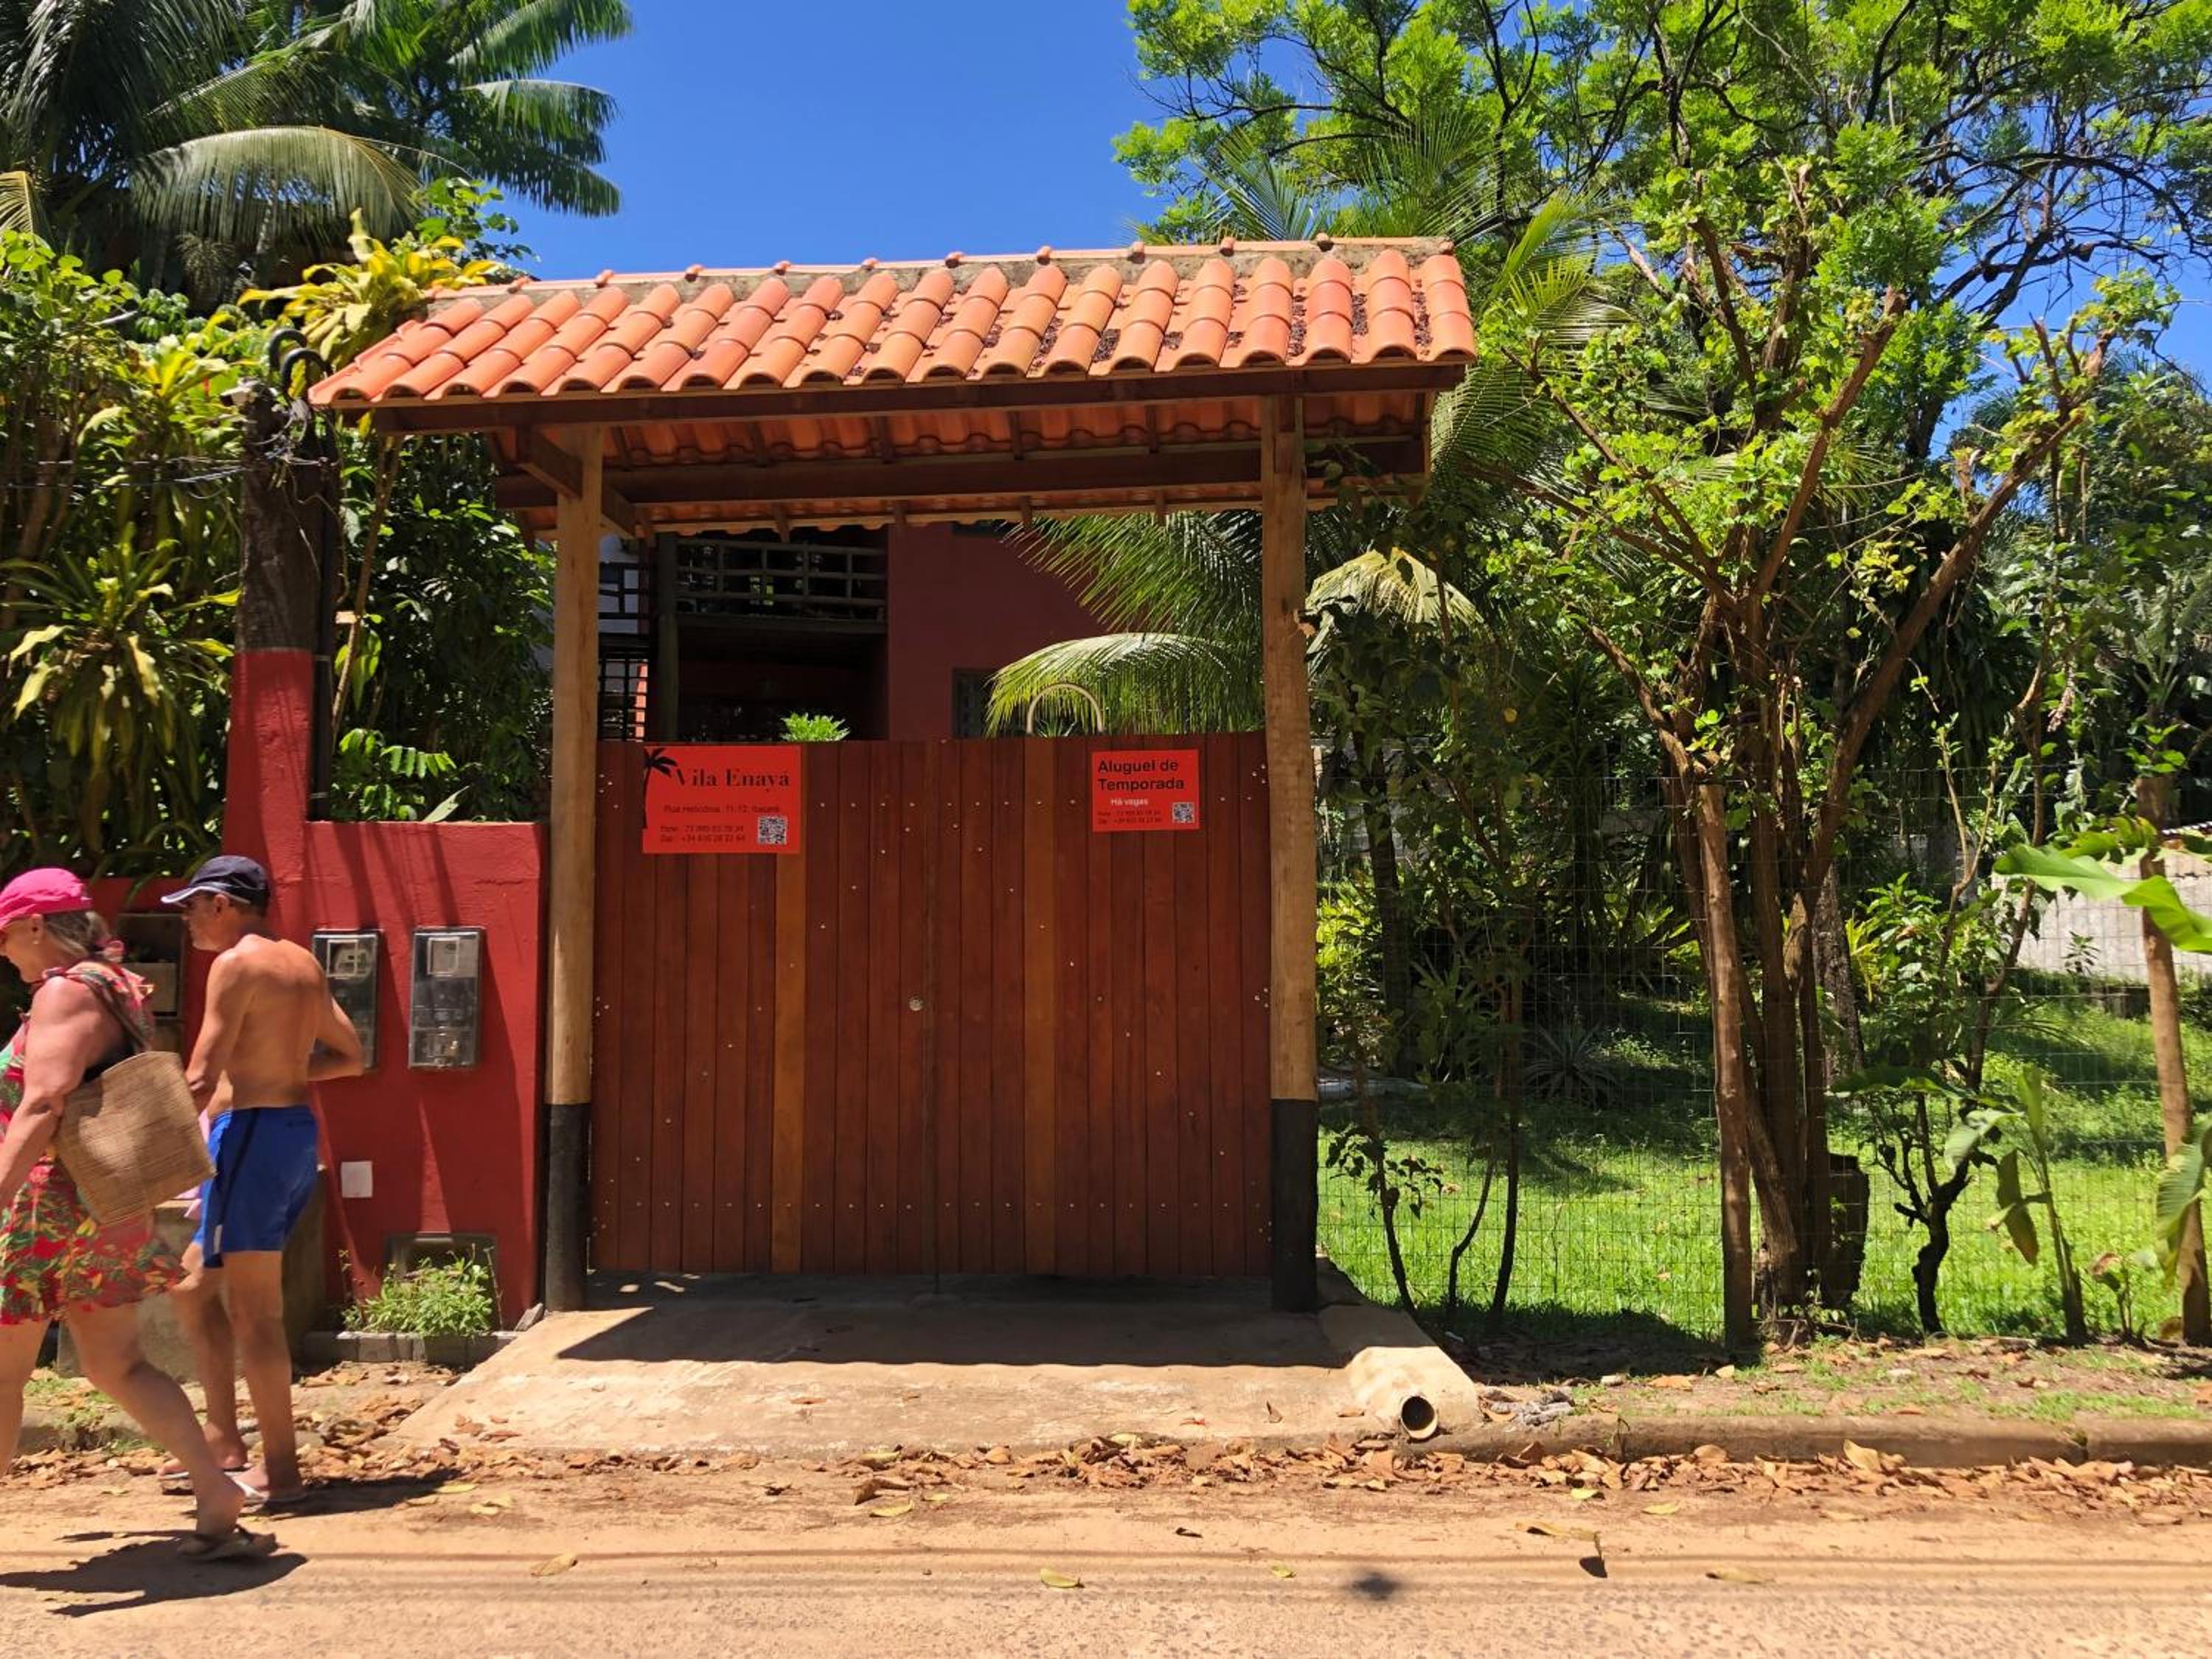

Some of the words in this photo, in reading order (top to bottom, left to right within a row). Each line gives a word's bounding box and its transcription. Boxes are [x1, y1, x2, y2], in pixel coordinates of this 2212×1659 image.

[1098, 759, 1155, 774] Aluguel
[1160, 759, 1179, 771] de
[674, 768, 718, 787] Vila
[726, 768, 789, 793] Enayá
[1098, 778, 1184, 793] Temporada
[1124, 799, 1149, 807] vagas
